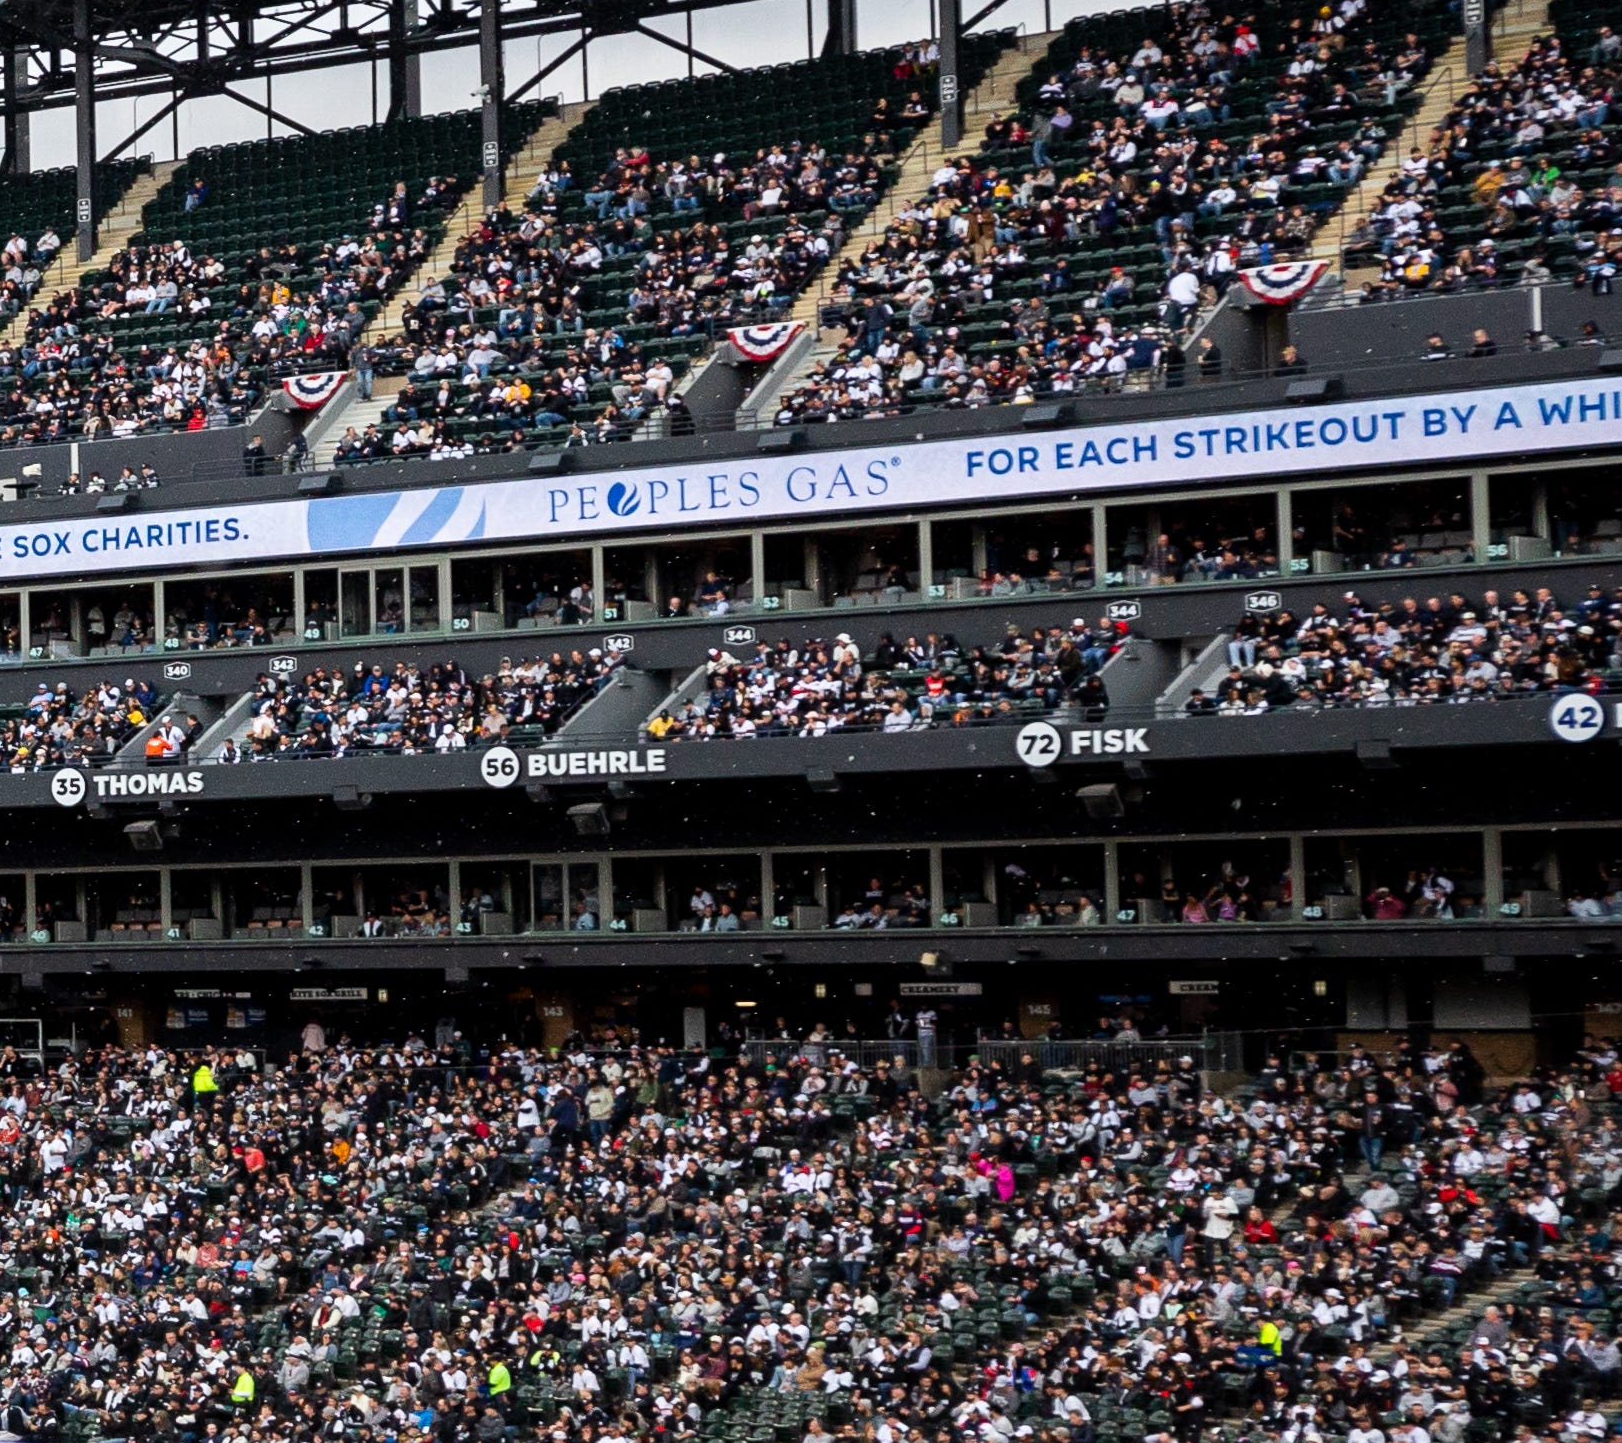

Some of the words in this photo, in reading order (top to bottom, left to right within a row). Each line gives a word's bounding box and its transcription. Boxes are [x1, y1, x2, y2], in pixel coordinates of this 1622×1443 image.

[966, 445, 1040, 478] FOR
[1055, 434, 1158, 470] EACH
[1173, 410, 1407, 460] STRIKEOUT
[1421, 404, 1478, 438] BY
[1493, 400, 1524, 431] A
[12, 531, 72, 559] SOX
[81, 517, 250, 553] CHARITIES.
[1249, 596, 1276, 608] 346
[1111, 606, 1137, 617] 344
[607, 638, 630, 649] 342
[727, 630, 751, 641] 344
[167, 666, 188, 676] 340
[273, 660, 294, 670] 342
[1558, 707, 1597, 728] 42
[1023, 735, 1054, 755] 72
[1071, 728, 1150, 754] FISK
[486, 758, 514, 775] 56
[528, 749, 665, 777] BUEHRLE
[56, 778, 79, 795] 35
[93, 772, 203, 797] THOMAS
